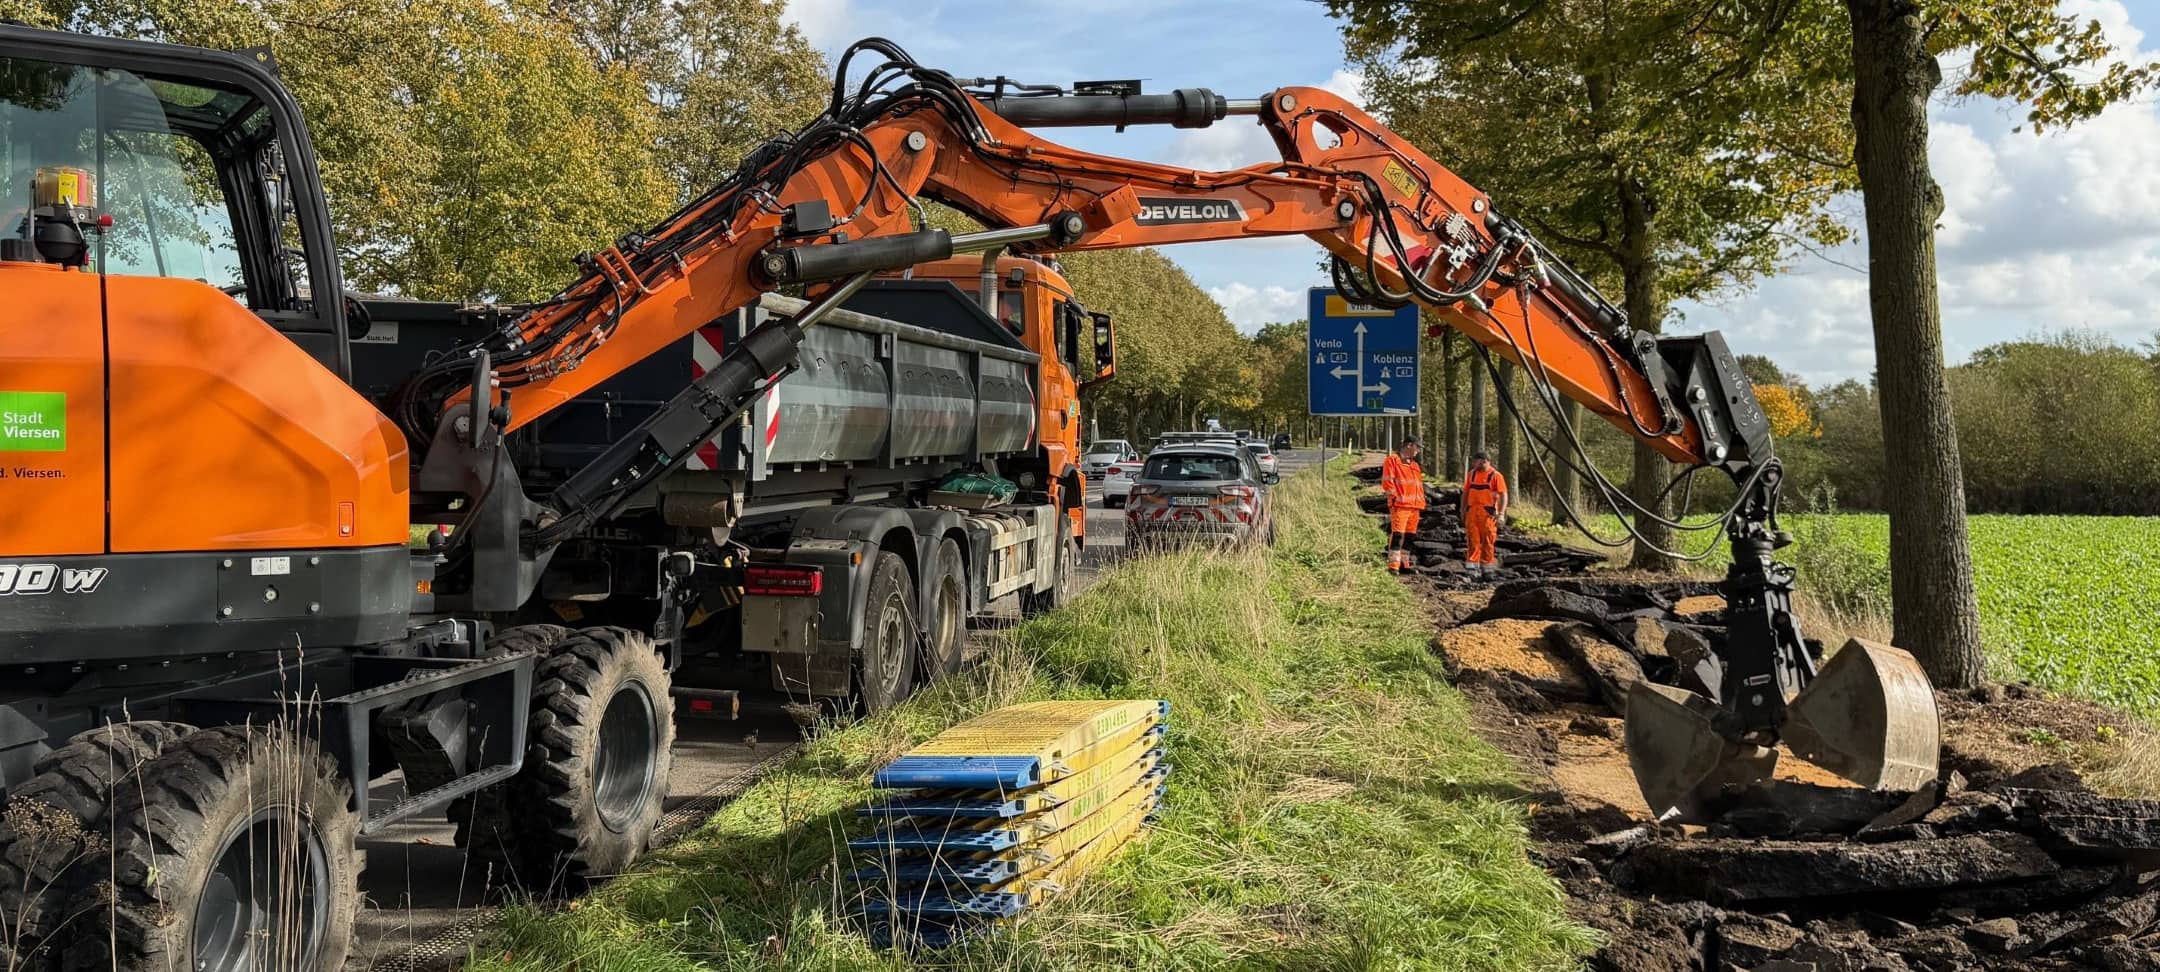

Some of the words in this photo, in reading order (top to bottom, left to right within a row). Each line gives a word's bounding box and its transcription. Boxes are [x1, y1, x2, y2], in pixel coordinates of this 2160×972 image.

[1138, 205, 1230, 220] DEVELON
[1314, 339, 1342, 349] Venlo
[1373, 354, 1414, 364] Koblenz
[3, 411, 43, 424] Stadt
[3, 426, 60, 438] Viersen
[13, 467, 66, 479] Viersen.
